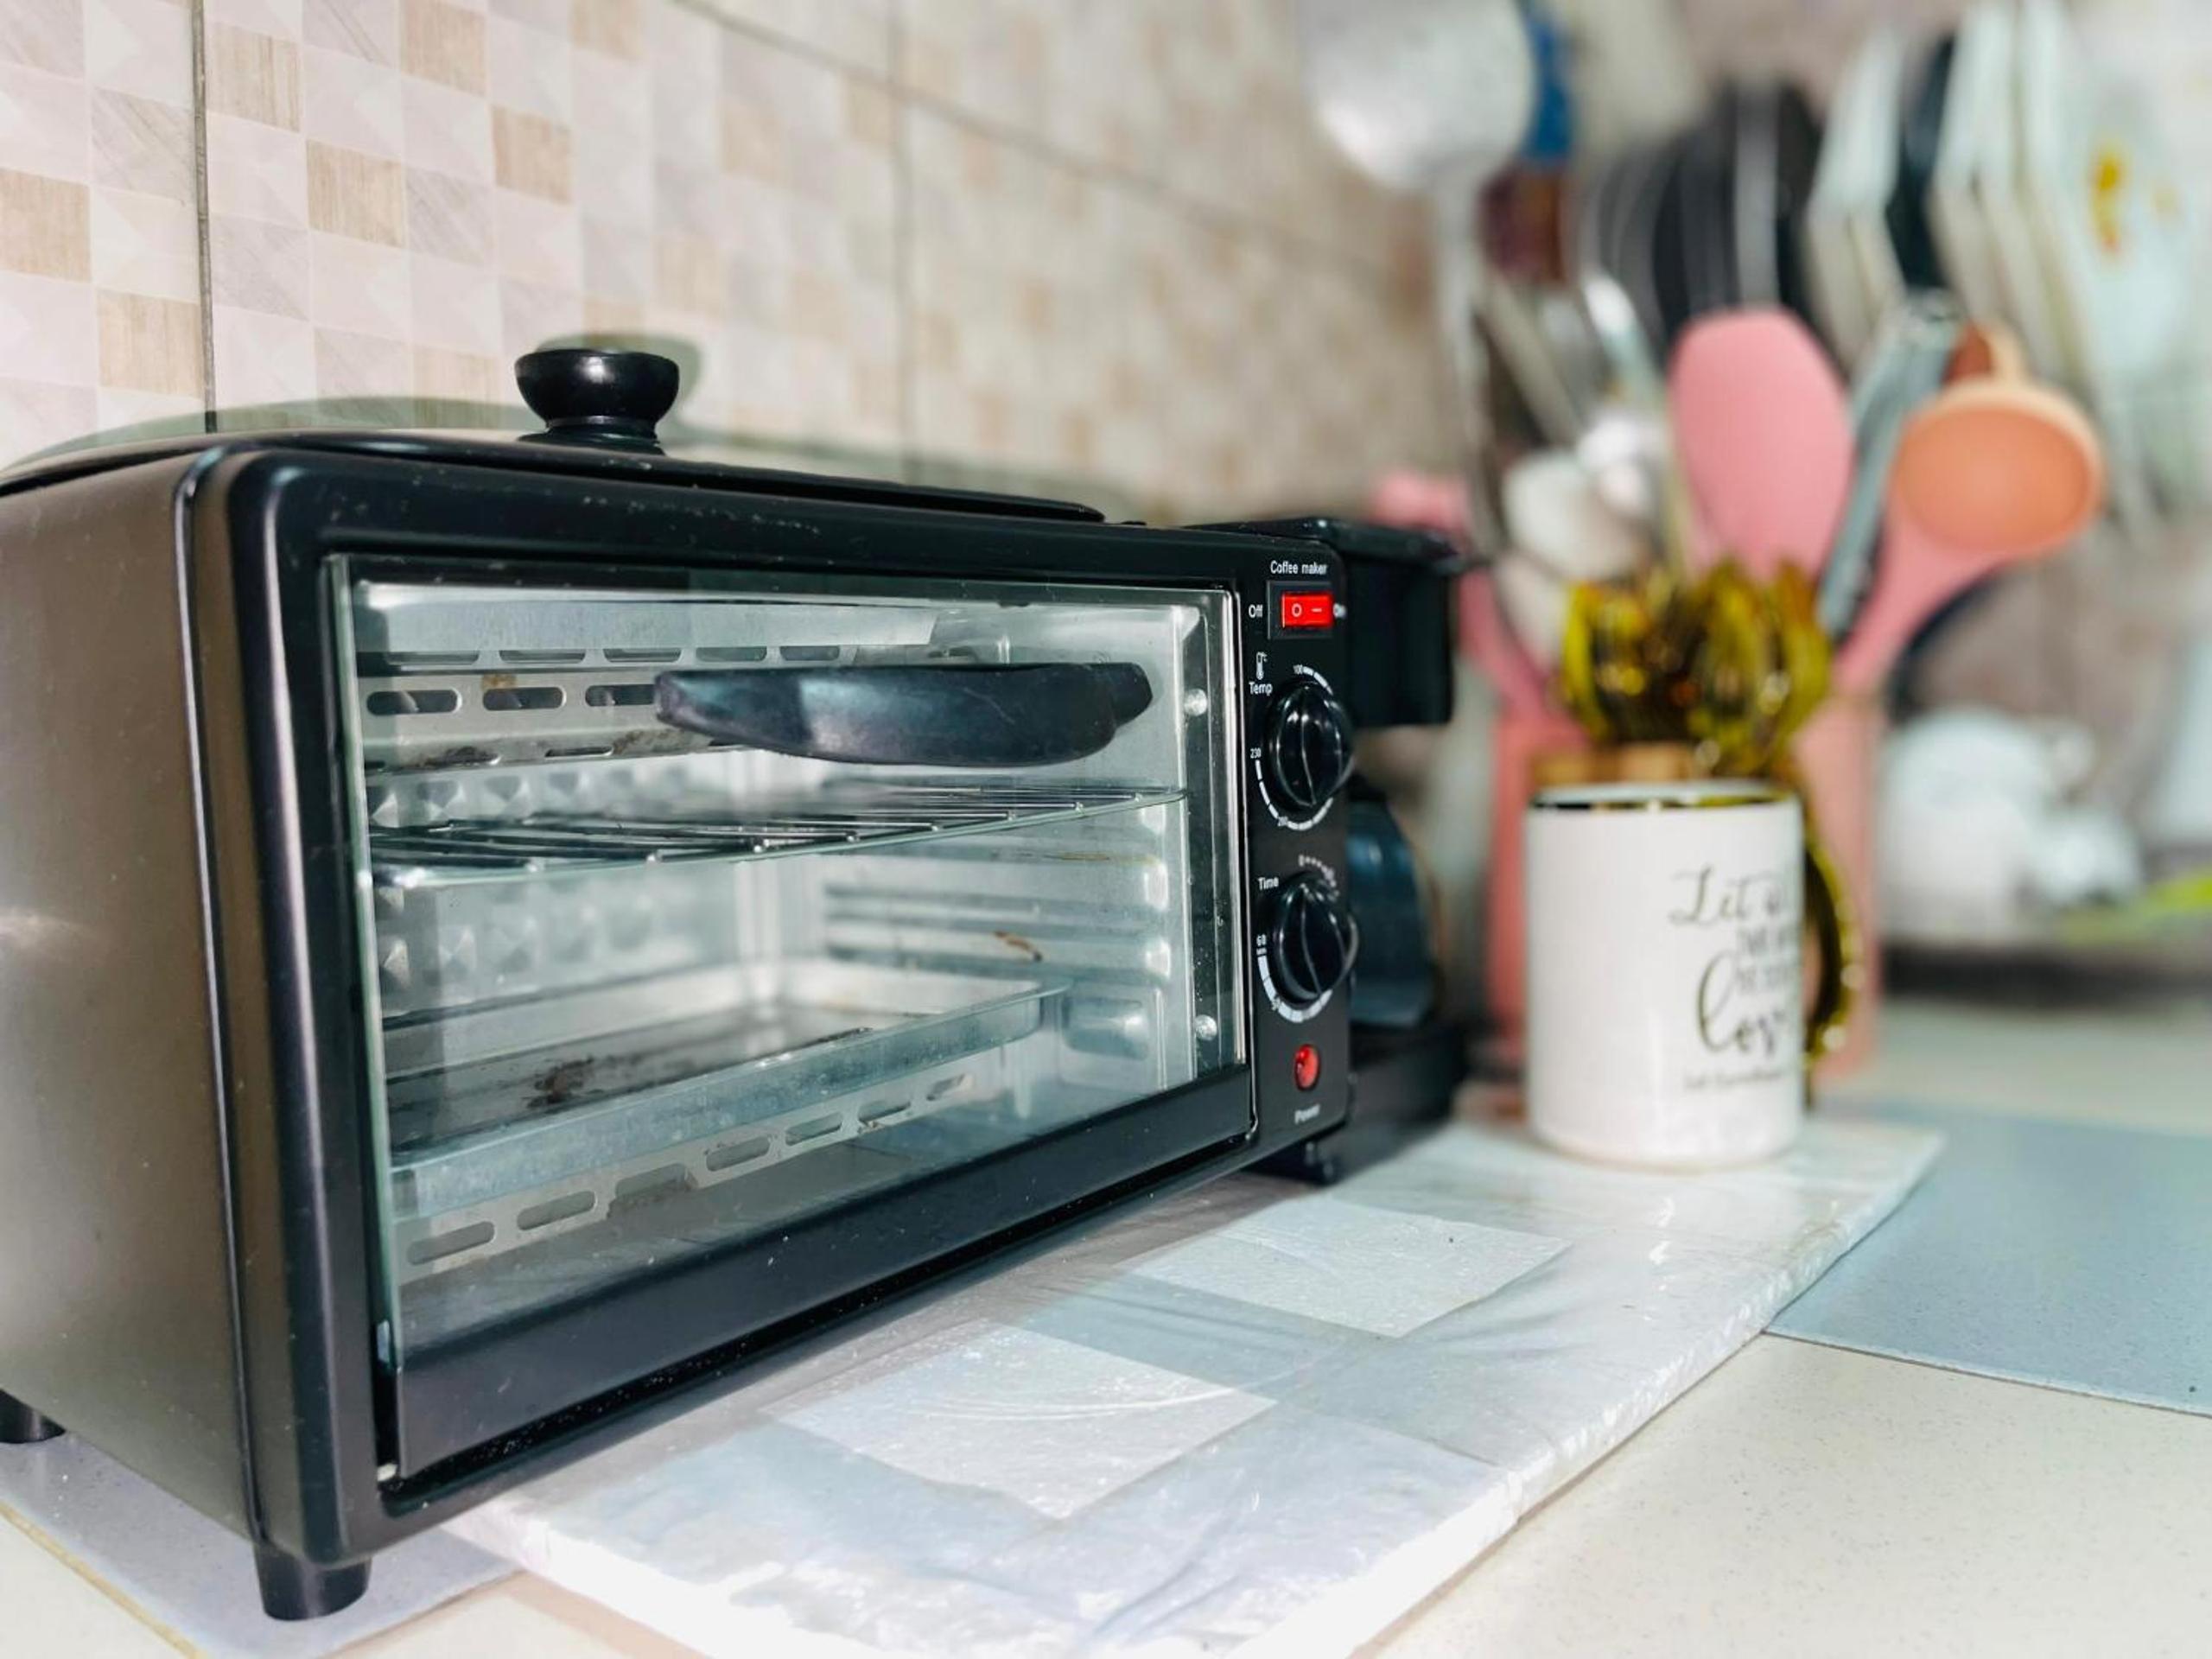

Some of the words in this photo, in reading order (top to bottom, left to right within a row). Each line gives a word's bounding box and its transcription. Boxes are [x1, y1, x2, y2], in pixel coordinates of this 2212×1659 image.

[1270, 560, 1298, 575] Coffee
[1301, 562, 1328, 575] maker
[1249, 605, 1263, 618] Off
[1248, 681, 1273, 696] Temp
[1258, 877, 1279, 891] Time
